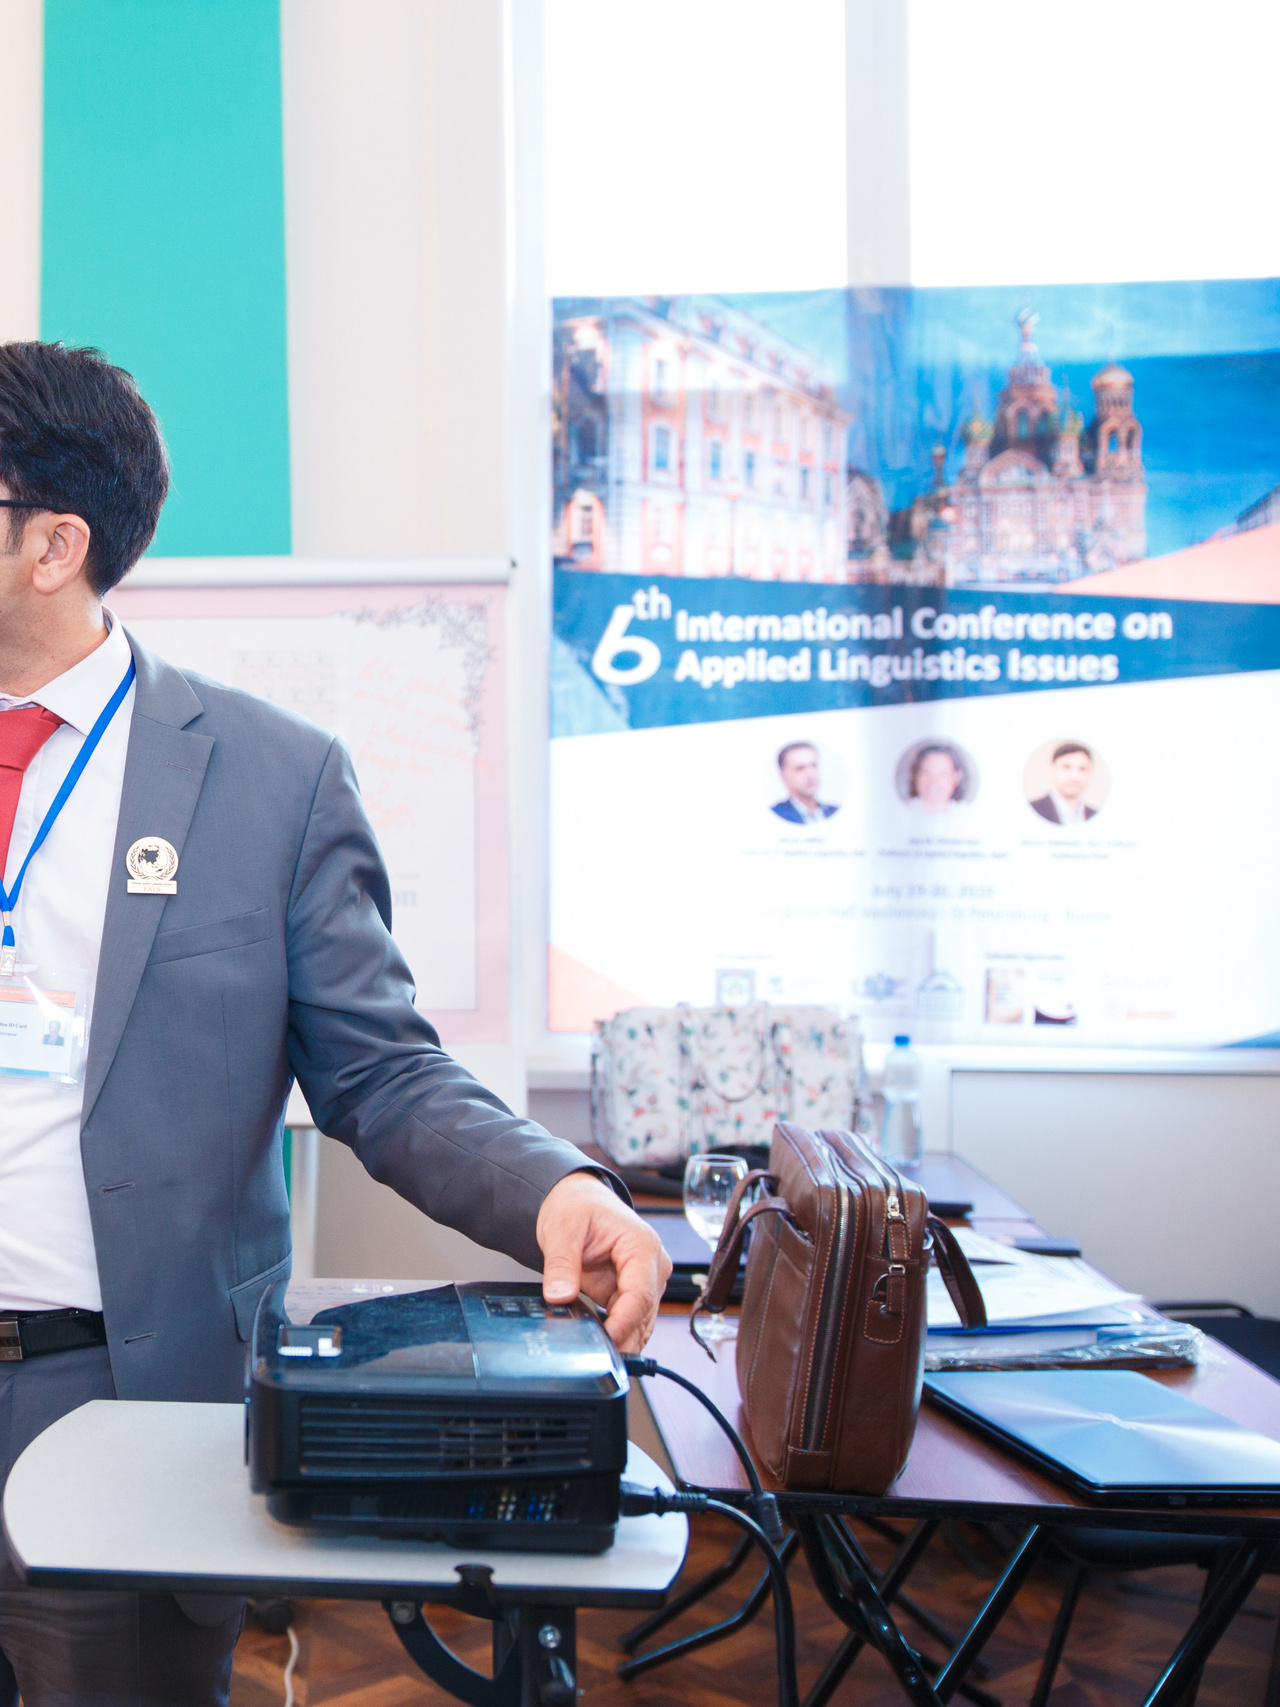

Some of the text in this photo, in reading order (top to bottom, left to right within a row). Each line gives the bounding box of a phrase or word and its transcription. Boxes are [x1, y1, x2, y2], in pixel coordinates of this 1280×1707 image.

[675, 604, 1173, 642] International Conference on
[674, 646, 1119, 689] Applied Linguistics Issues
